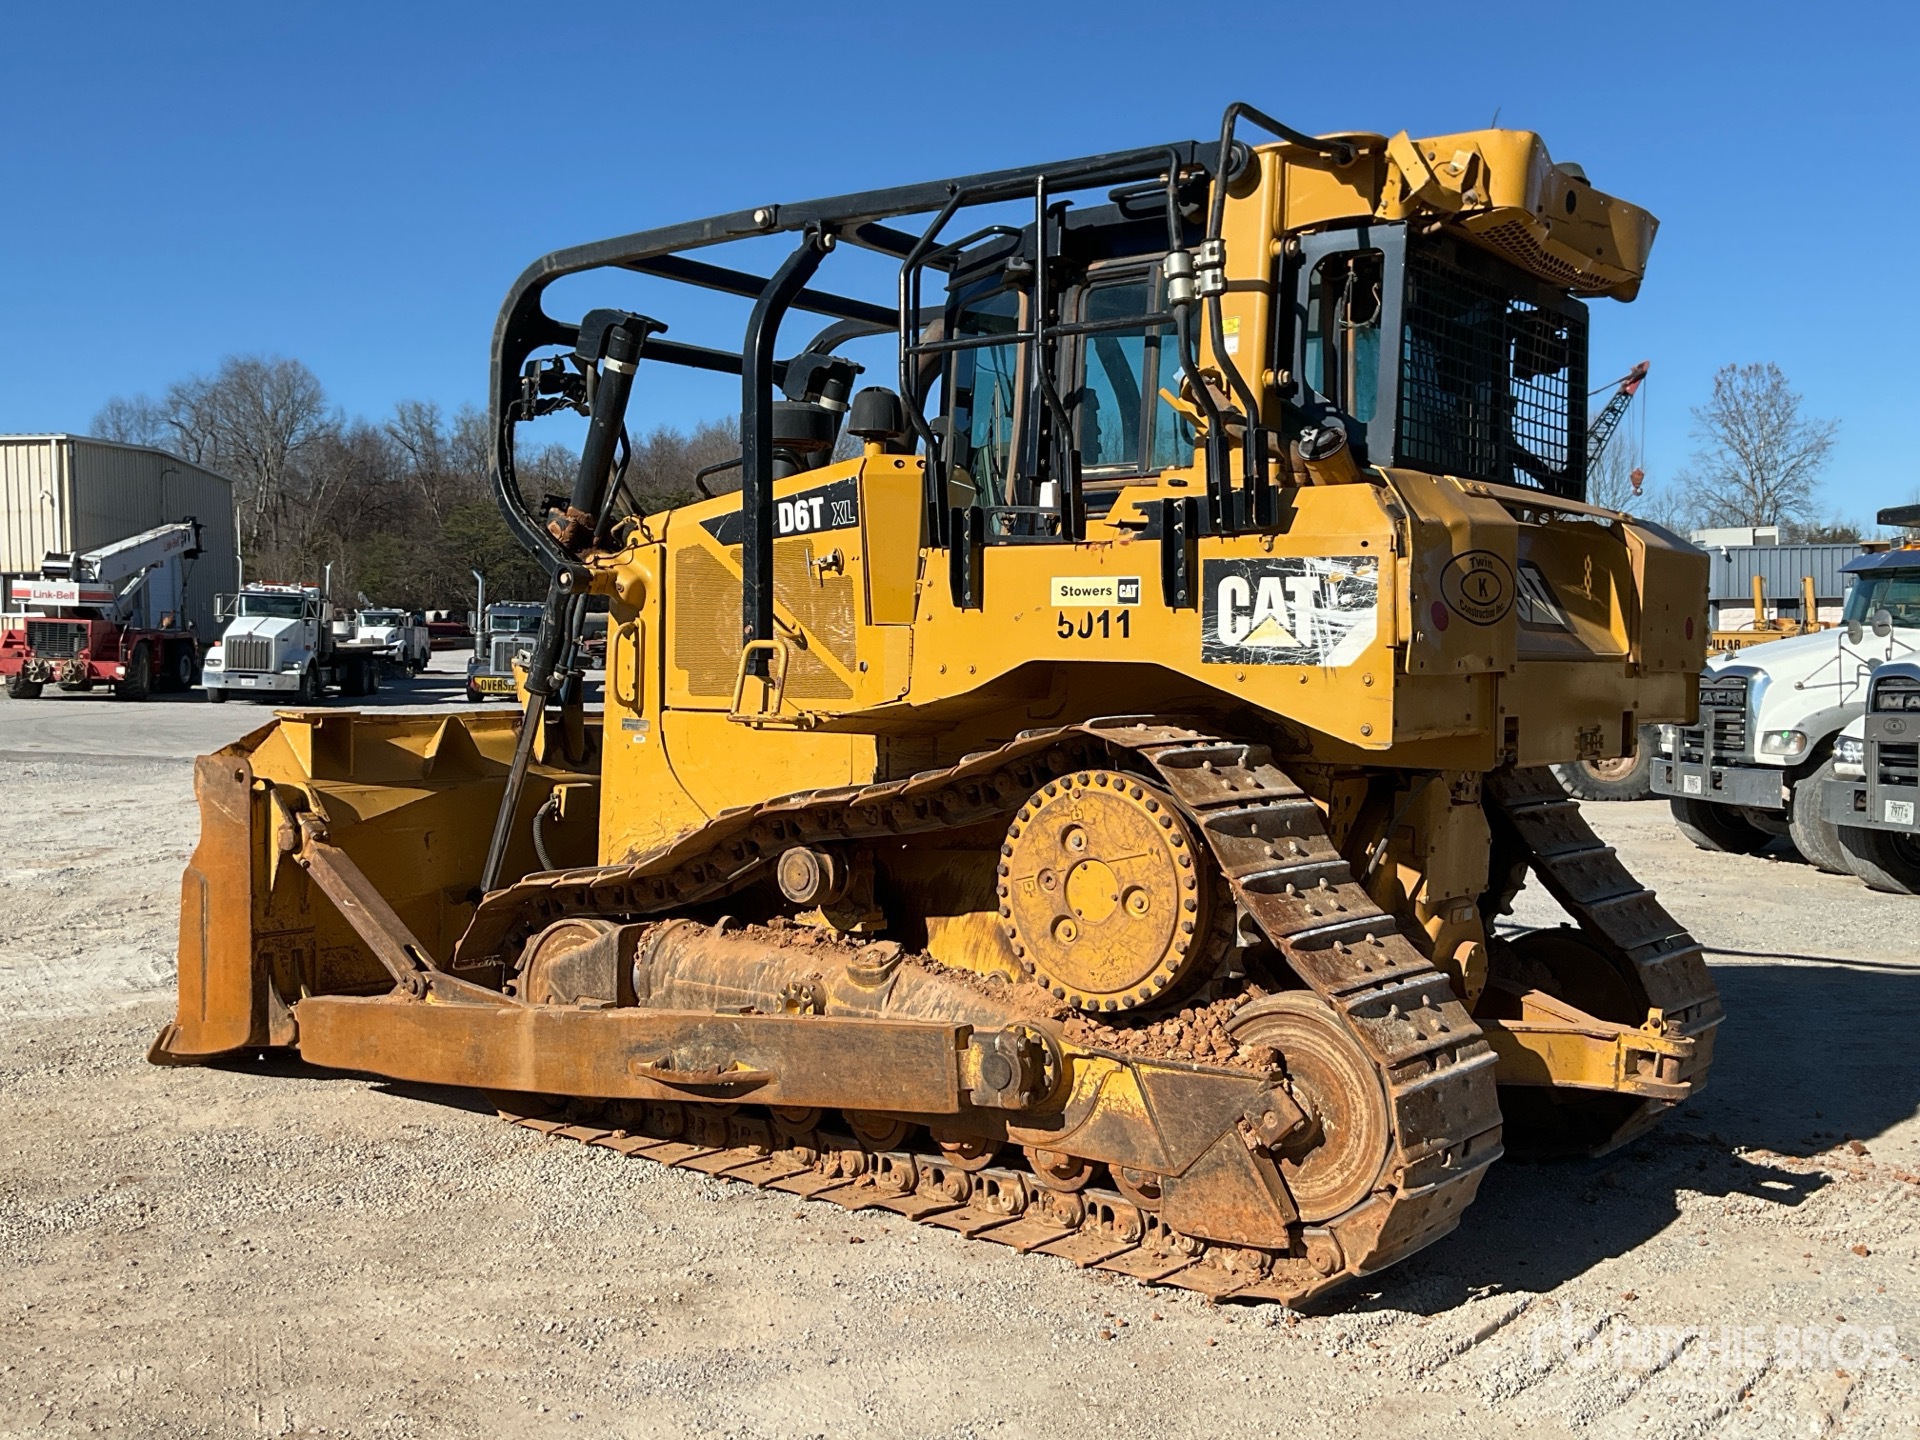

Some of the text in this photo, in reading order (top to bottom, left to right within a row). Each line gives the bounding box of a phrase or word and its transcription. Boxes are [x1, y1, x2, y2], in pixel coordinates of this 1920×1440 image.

[778, 496, 856, 534] D6T XL
[1469, 556, 1493, 570] Twin
[33, 589, 76, 600] Link-Belt
[1060, 584, 1139, 598] Stowers CAT
[1478, 578, 1489, 597] K
[1517, 567, 1565, 626] AT
[1217, 575, 1321, 648] CAT
[1459, 598, 1496, 619] Construction
[1713, 639, 1741, 650] ILLAR
[1701, 691, 1744, 704] ACK
[1879, 693, 1920, 709] MA
